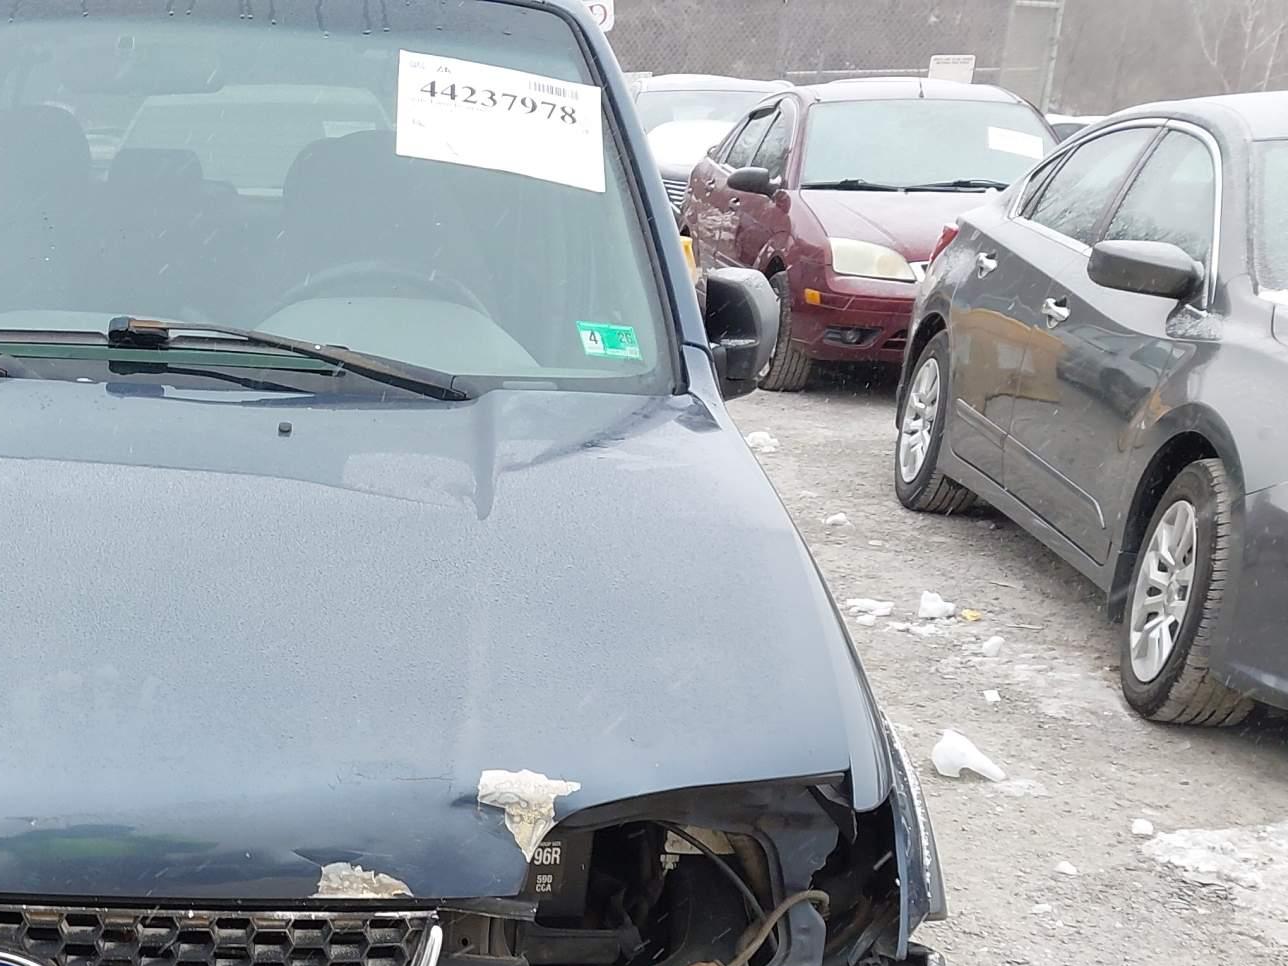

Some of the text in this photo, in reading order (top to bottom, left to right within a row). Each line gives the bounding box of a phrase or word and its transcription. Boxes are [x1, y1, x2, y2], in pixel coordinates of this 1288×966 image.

[419, 80, 577, 125] 44237978
[588, 330, 598, 345] 4
[533, 847, 561, 866] 96R
[535, 883, 552, 892] CCA
